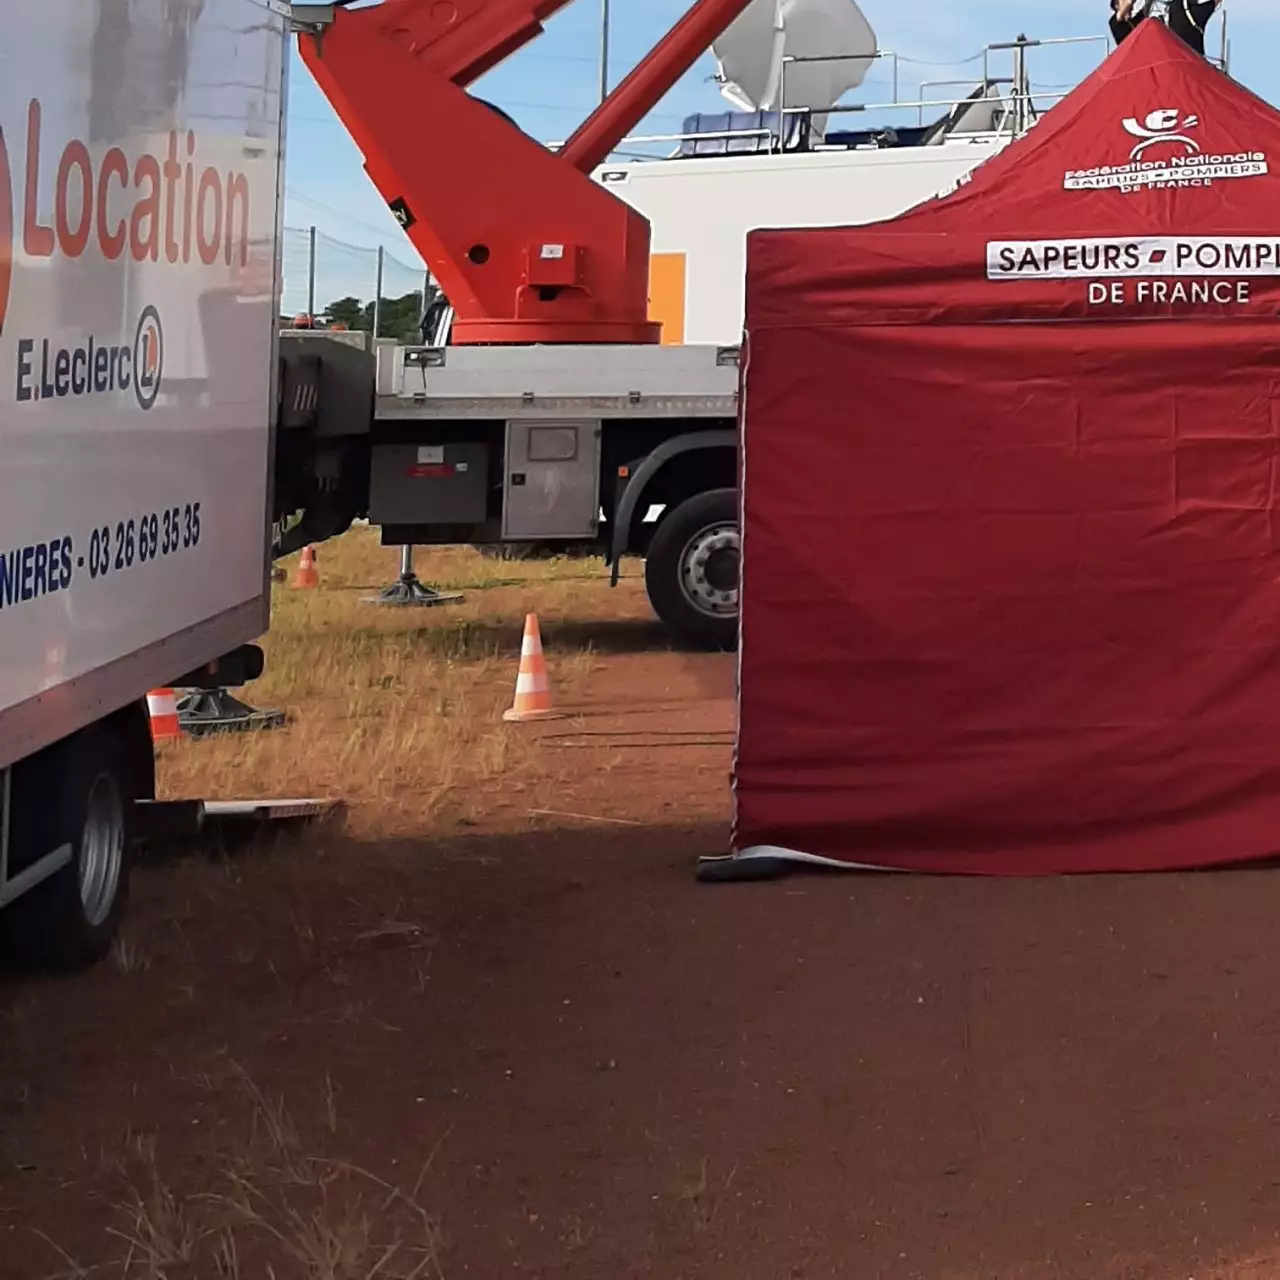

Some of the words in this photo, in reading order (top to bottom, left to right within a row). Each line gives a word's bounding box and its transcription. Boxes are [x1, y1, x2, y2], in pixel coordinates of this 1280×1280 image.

[1065, 160, 1166, 180] Fédération
[1171, 151, 1265, 167] Nationale
[1070, 173, 1150, 187] SAPEURS
[1169, 163, 1262, 177] POMPIERS
[23, 97, 249, 268] Location
[1120, 184, 1141, 194] DE
[1148, 178, 1213, 190] FRANCE
[998, 243, 1140, 272] SAPEURS
[1088, 281, 1124, 305] DE
[1137, 280, 1251, 304] FRANCE
[16, 334, 131, 402] E.Leclerc
[89, 525, 110, 580] 03
[115, 518, 135, 570] 26
[139, 512, 158, 562] 69
[162, 506, 180, 555] 35
[183, 501, 201, 548] 35
